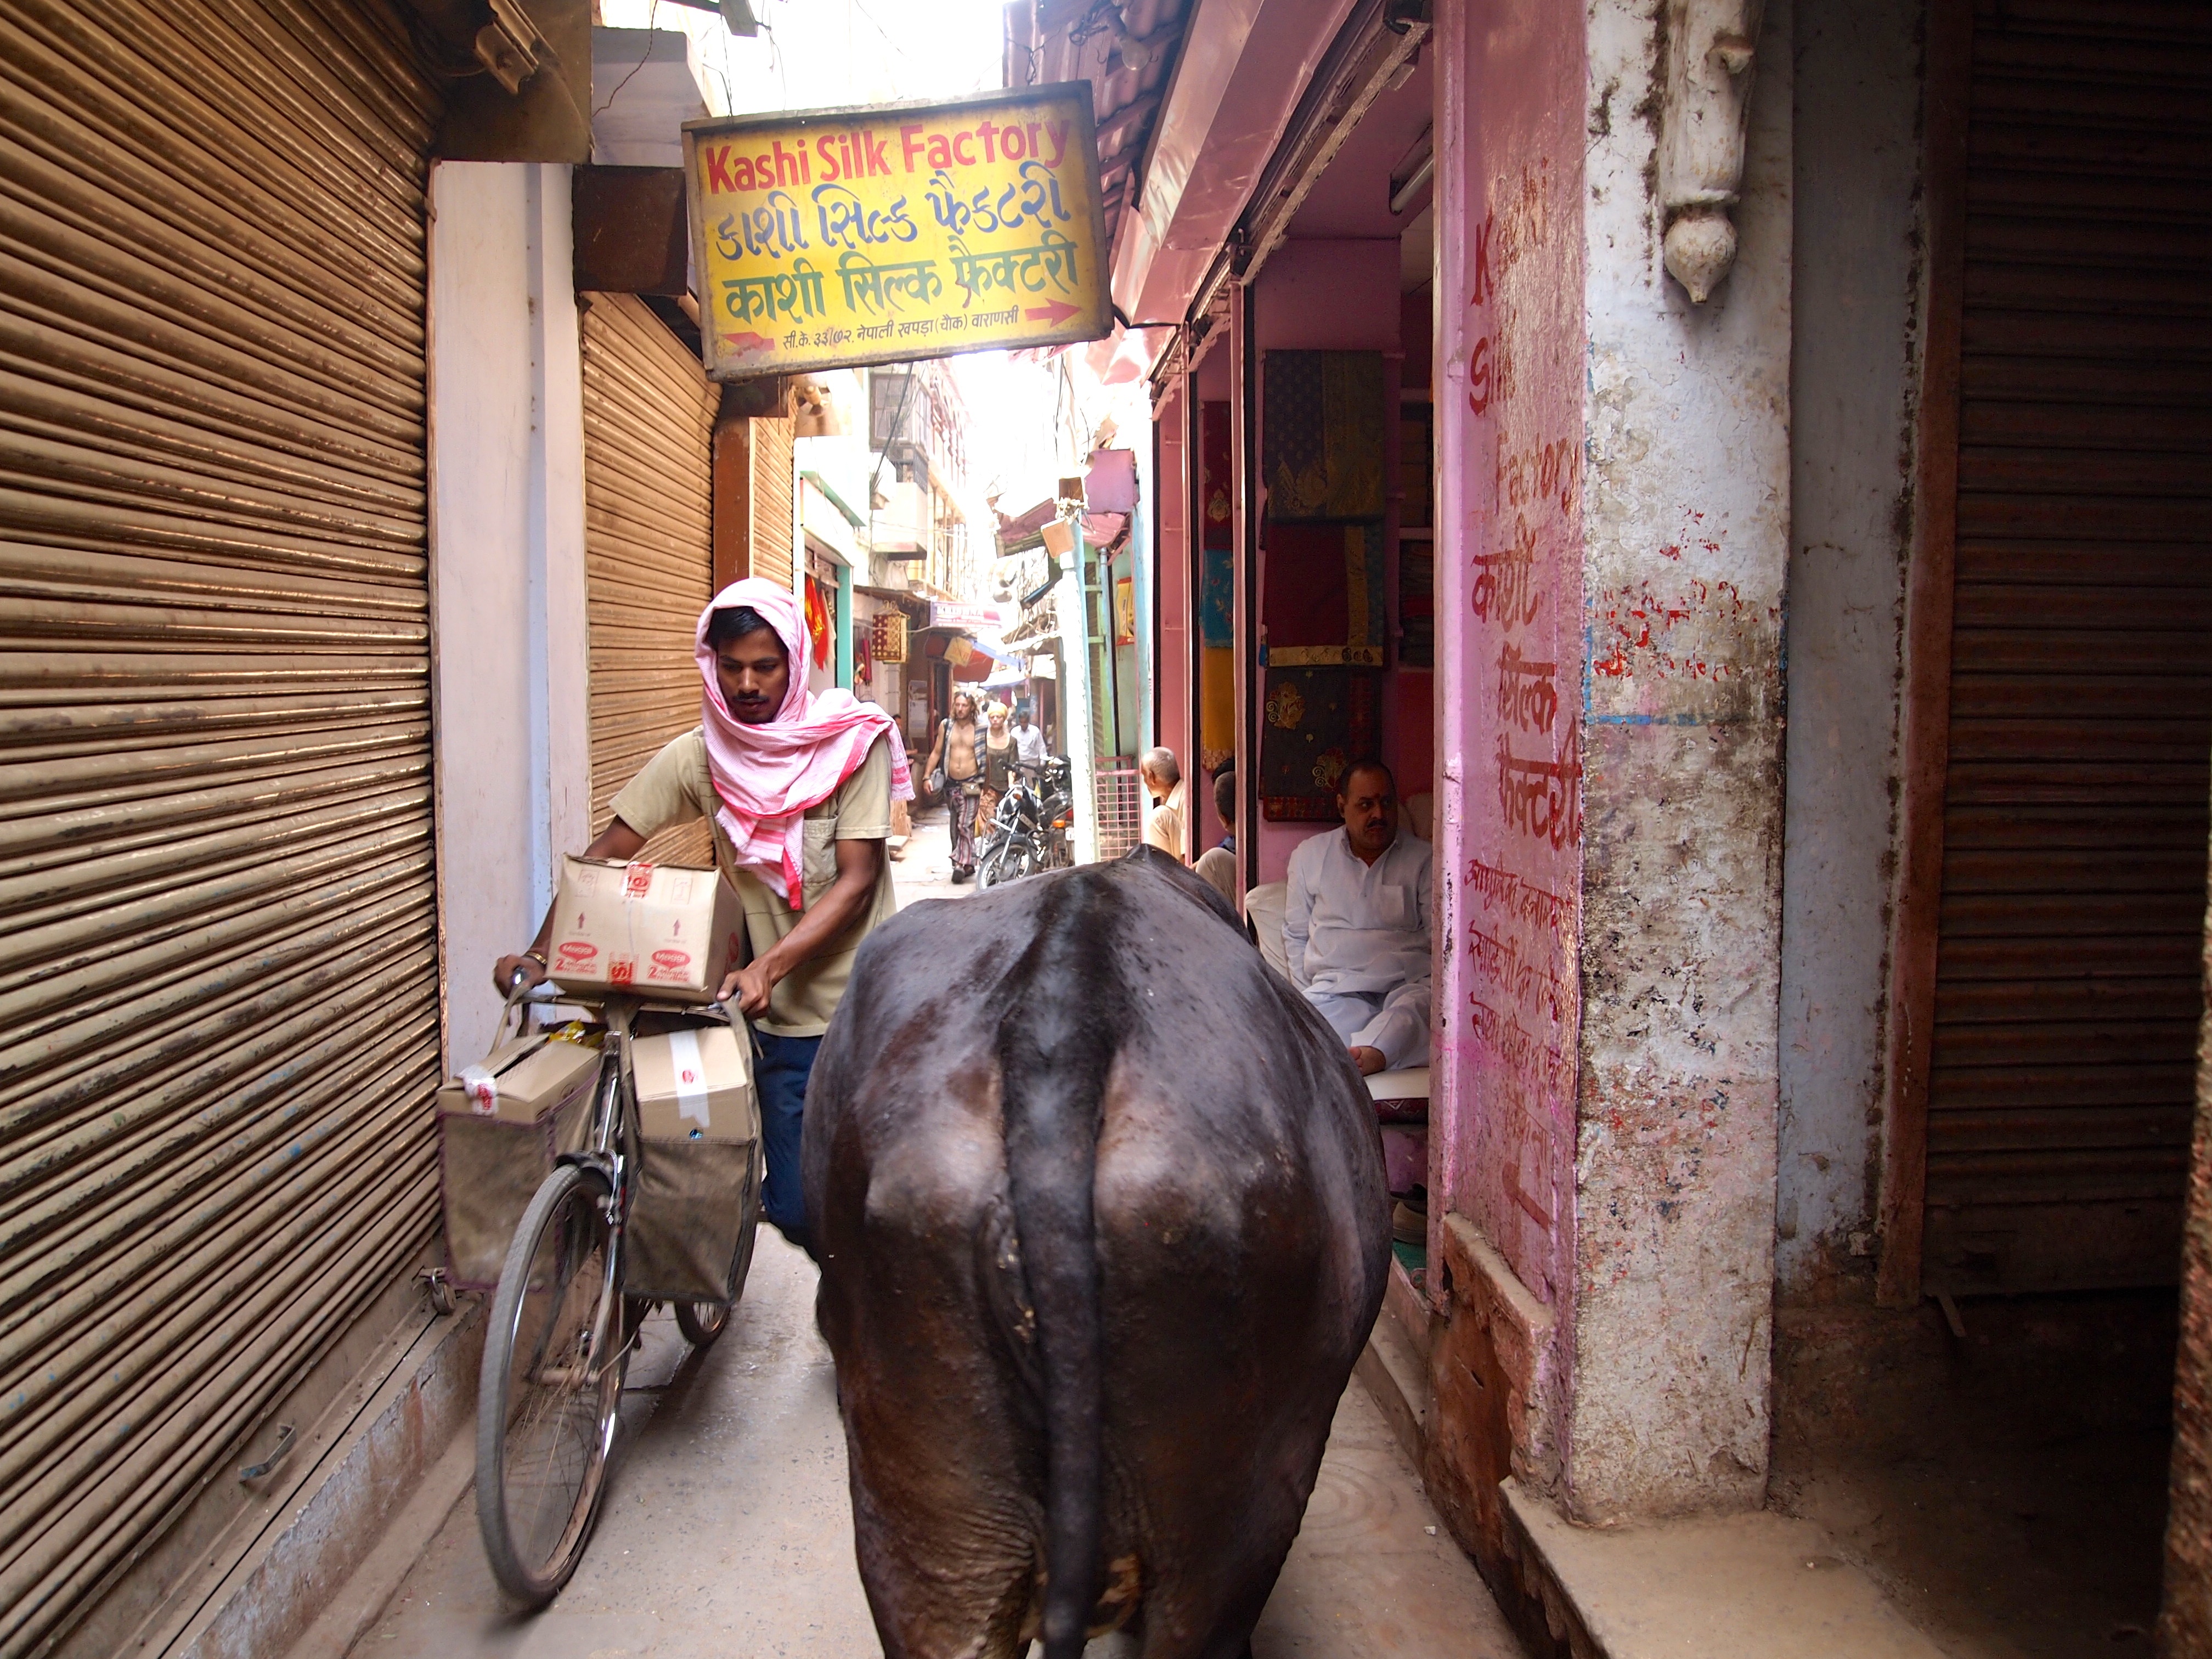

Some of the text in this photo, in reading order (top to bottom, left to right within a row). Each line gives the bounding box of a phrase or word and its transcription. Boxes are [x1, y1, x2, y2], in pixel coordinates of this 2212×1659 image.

[706, 119, 1069, 195] Kashi Silk Factory
[715, 190, 810, 261] કાશી
[811, 183, 918, 250] સિલ્ક
[721, 235, 1080, 325] काशी सिल्क फैक्टरी
[856, 318, 894, 341] नेपाली
[971, 304, 1019, 328] वाराणसी
[1470, 512, 1538, 633] काशी
[555, 958, 564, 972] 2
[648, 966, 657, 979] 2
